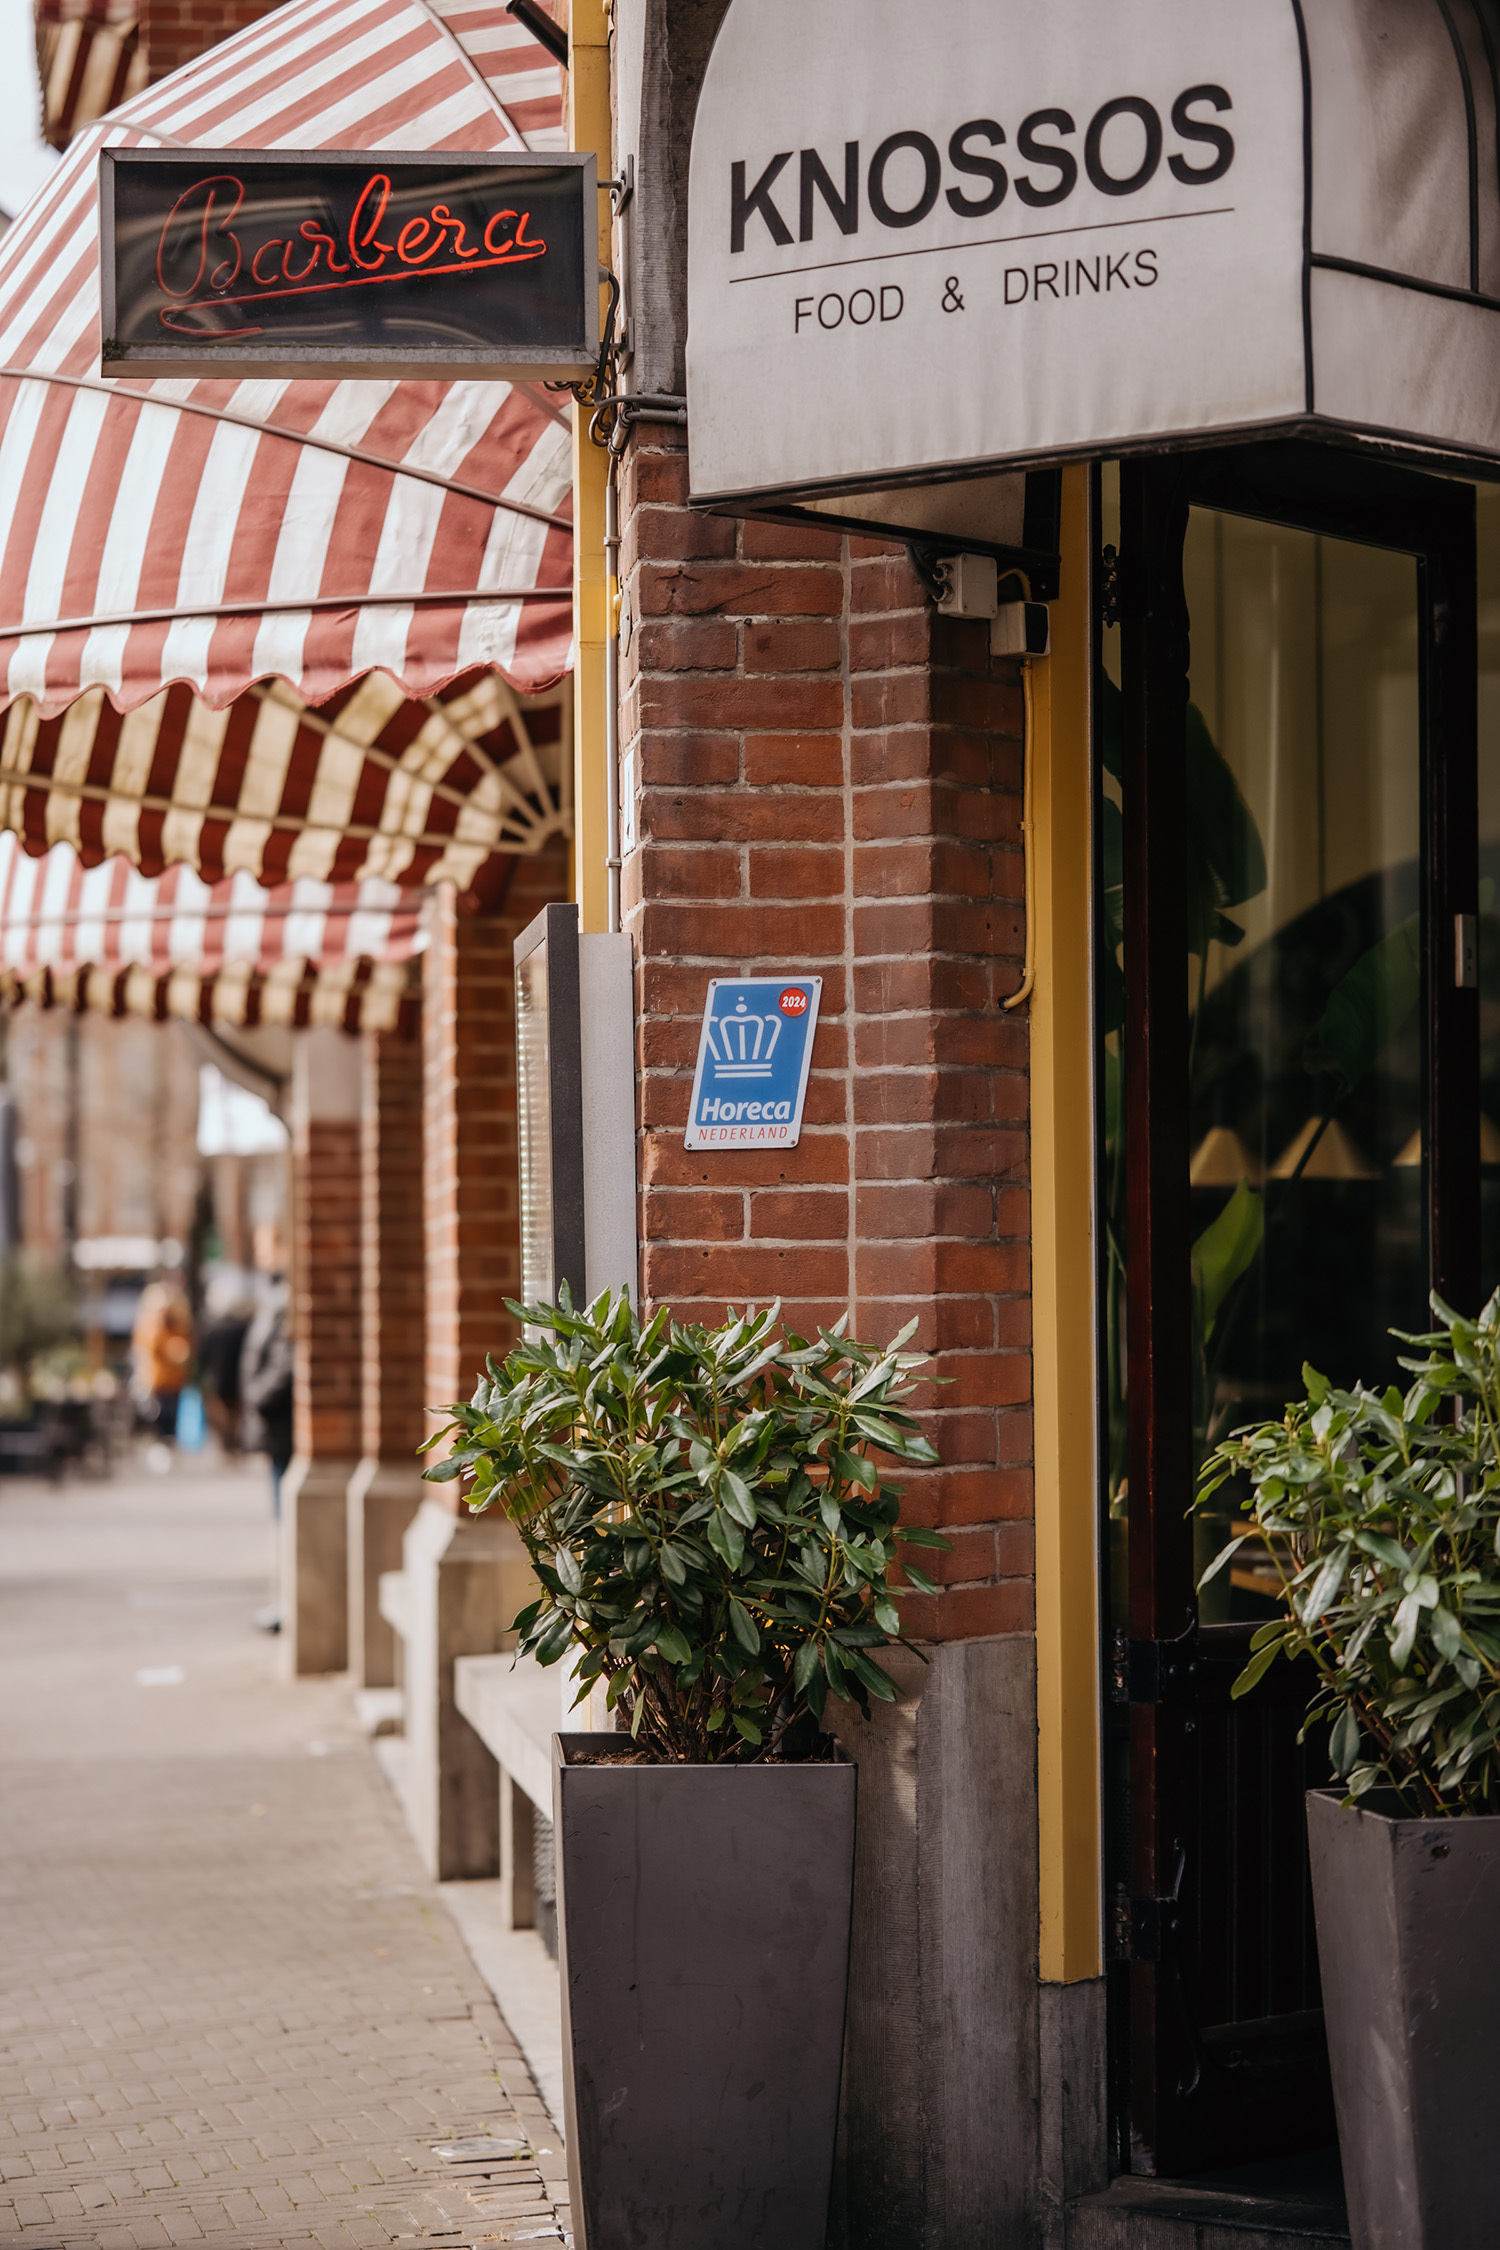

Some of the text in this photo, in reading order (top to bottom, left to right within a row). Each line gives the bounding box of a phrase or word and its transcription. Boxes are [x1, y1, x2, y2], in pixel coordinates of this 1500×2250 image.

[729, 83, 1236, 254] KNOSSOS
[156, 173, 546, 299] Barbera
[794, 249, 1160, 334] FOOD & DRINKS
[781, 996, 806, 1008] 2024
[698, 1126, 789, 1141] NEDERLAND
[700, 1097, 792, 1122] Horeca
